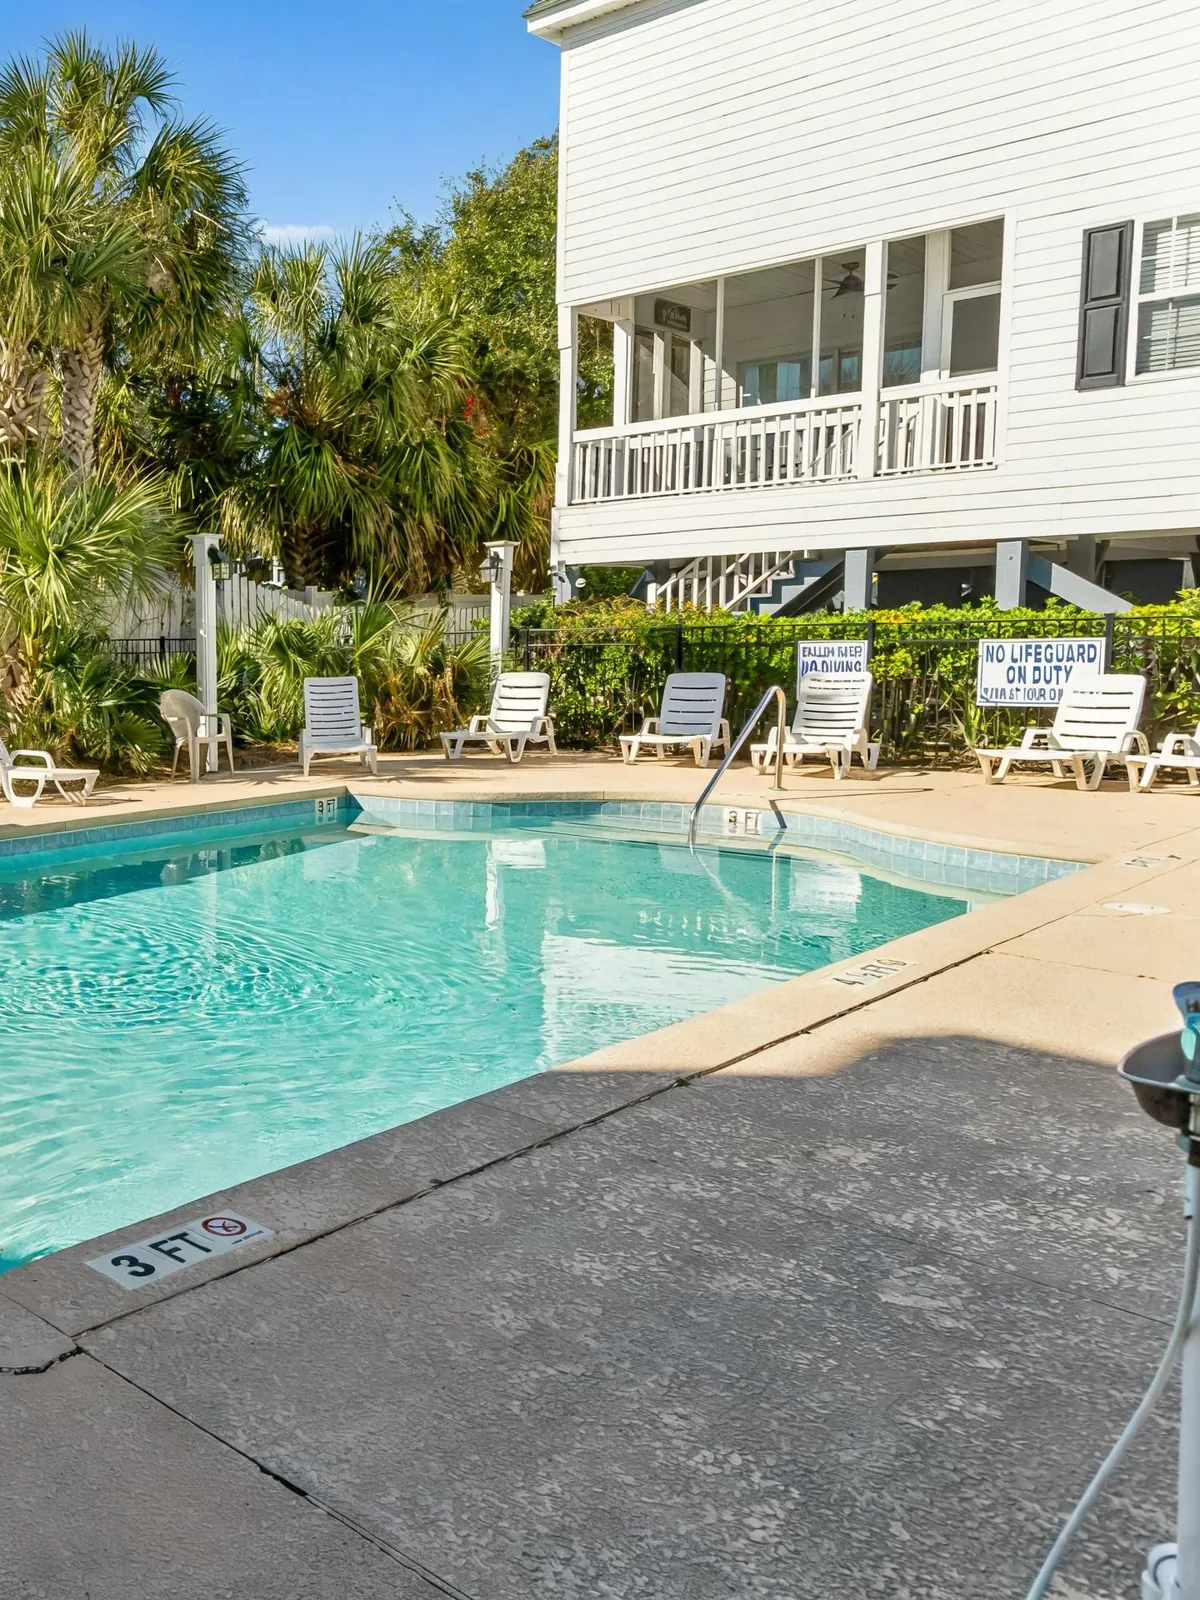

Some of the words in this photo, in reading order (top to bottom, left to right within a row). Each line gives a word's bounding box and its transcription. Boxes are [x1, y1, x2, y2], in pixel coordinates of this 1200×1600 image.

[986, 644, 1005, 663] NO
[1011, 644, 1097, 663] LIFEGUARD
[821, 660, 862, 673] DIVING
[1006, 665, 1027, 684] ON
[1032, 665, 1073, 685] DUTY
[111, 1255, 156, 1277] 3
[148, 1231, 212, 1263] FT
